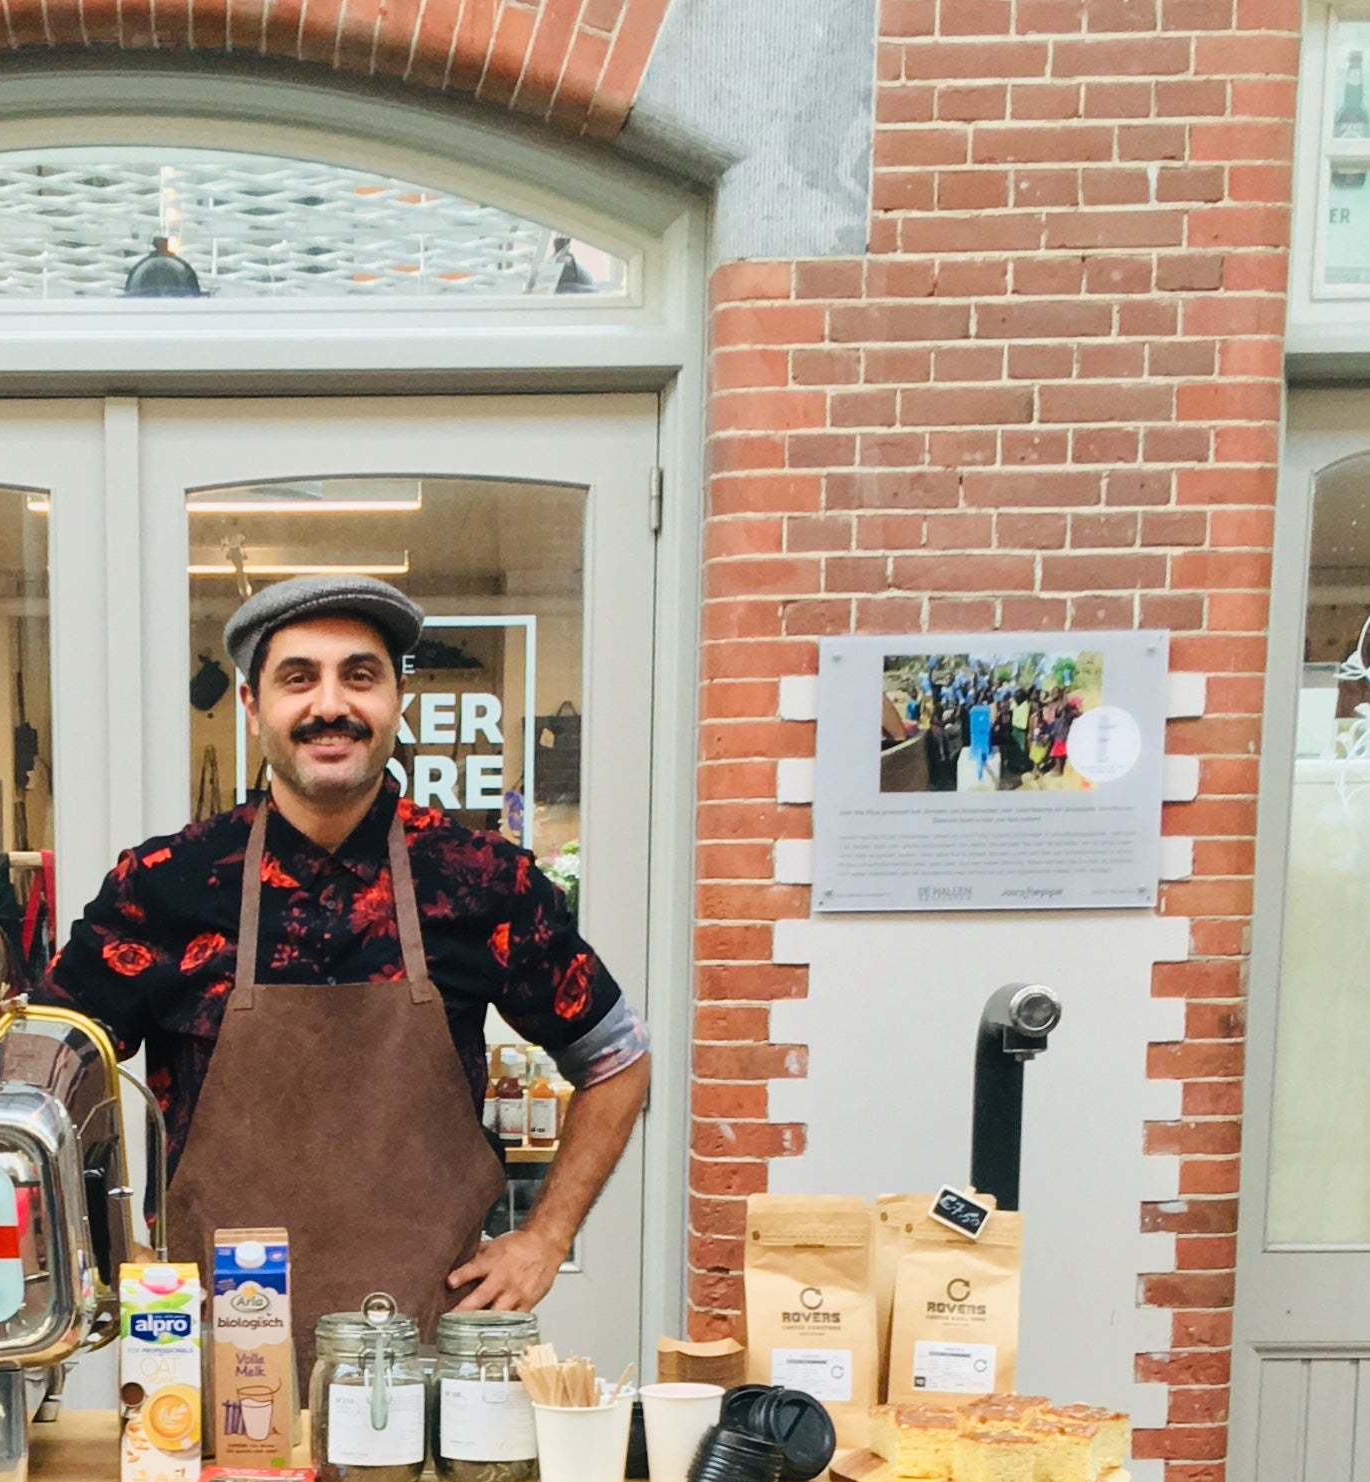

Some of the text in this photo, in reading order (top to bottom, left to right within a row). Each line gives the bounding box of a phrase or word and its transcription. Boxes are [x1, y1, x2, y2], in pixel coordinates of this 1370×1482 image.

[236, 1297, 263, 1307] Arla
[926, 1301, 987, 1315] ROVERS
[217, 1316, 284, 1330] biologisch
[781, 1311, 841, 1323] ROVERS
[134, 1314, 188, 1337] alpro
[235, 1366, 266, 1377] Melk
